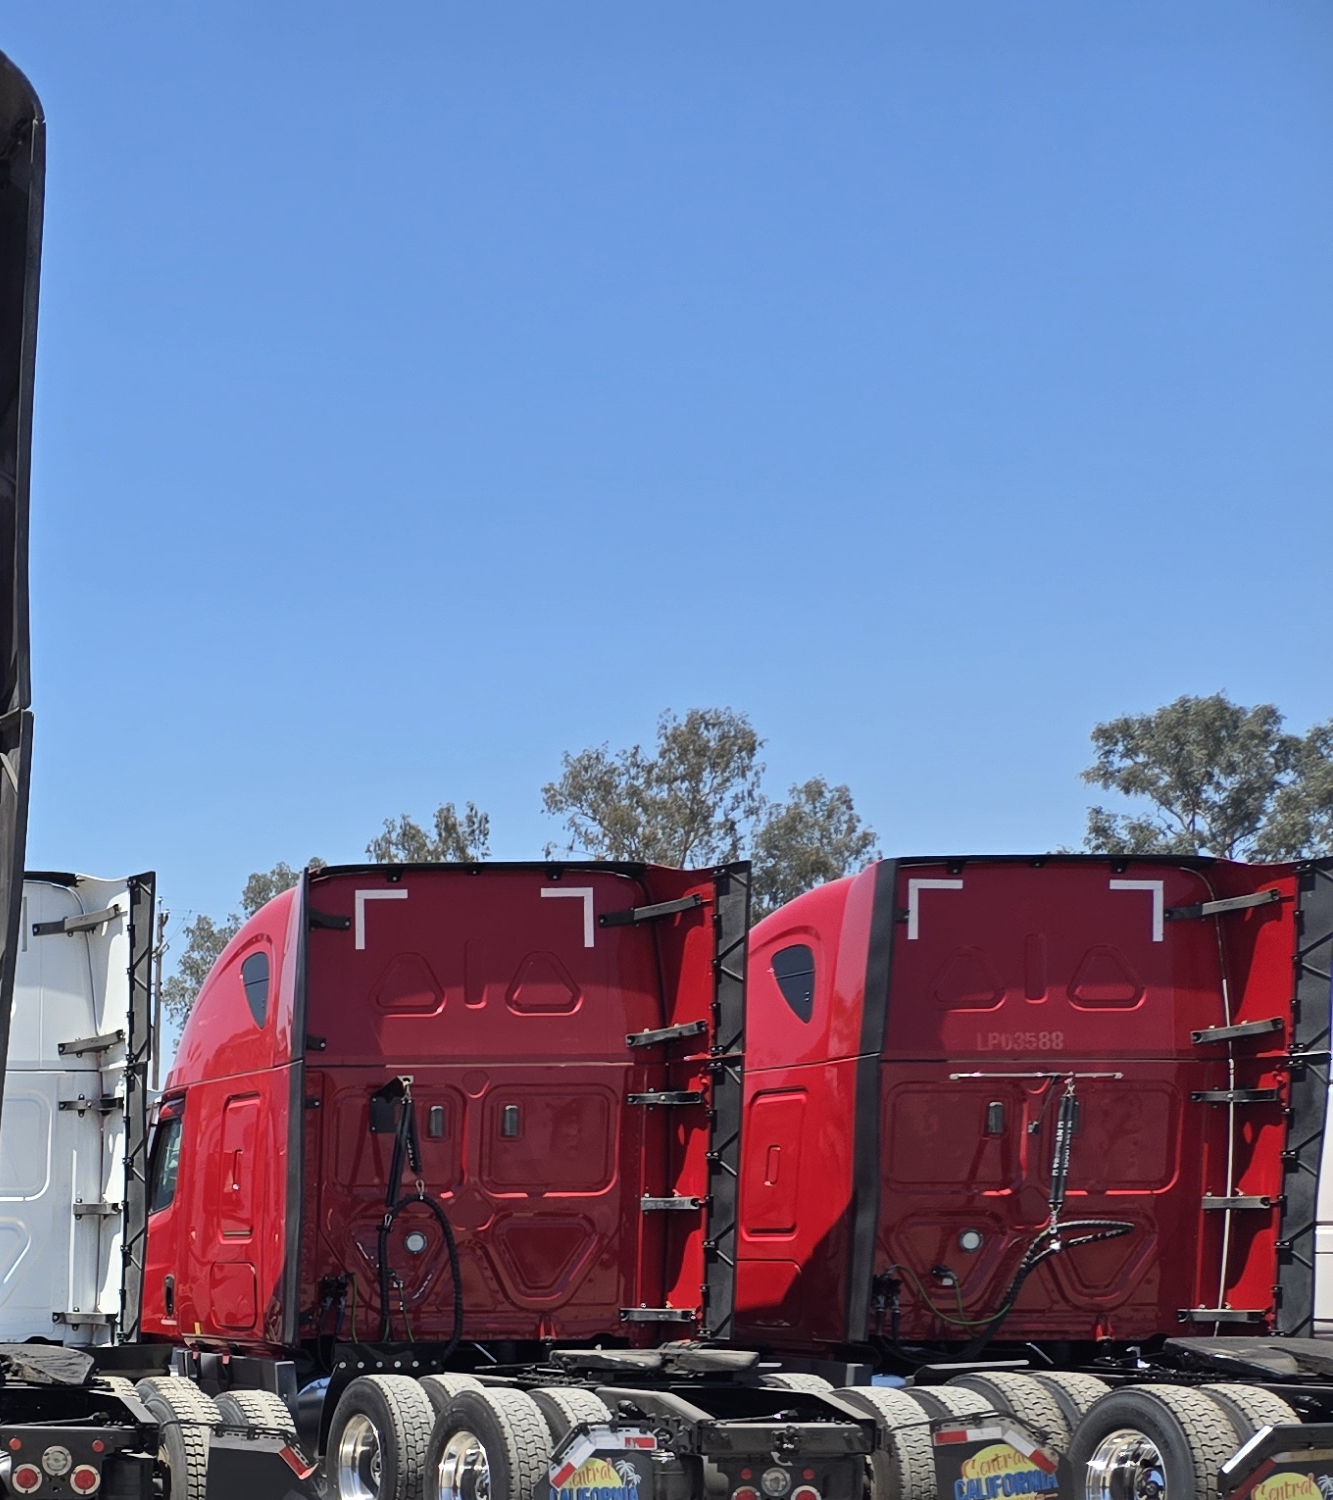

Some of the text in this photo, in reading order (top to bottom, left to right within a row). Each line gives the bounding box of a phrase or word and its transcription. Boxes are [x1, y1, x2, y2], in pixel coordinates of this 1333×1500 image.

[976, 1031, 1064, 1051] LP03588
[568, 1457, 614, 1488] entral
[961, 1451, 1029, 1479] Centra
